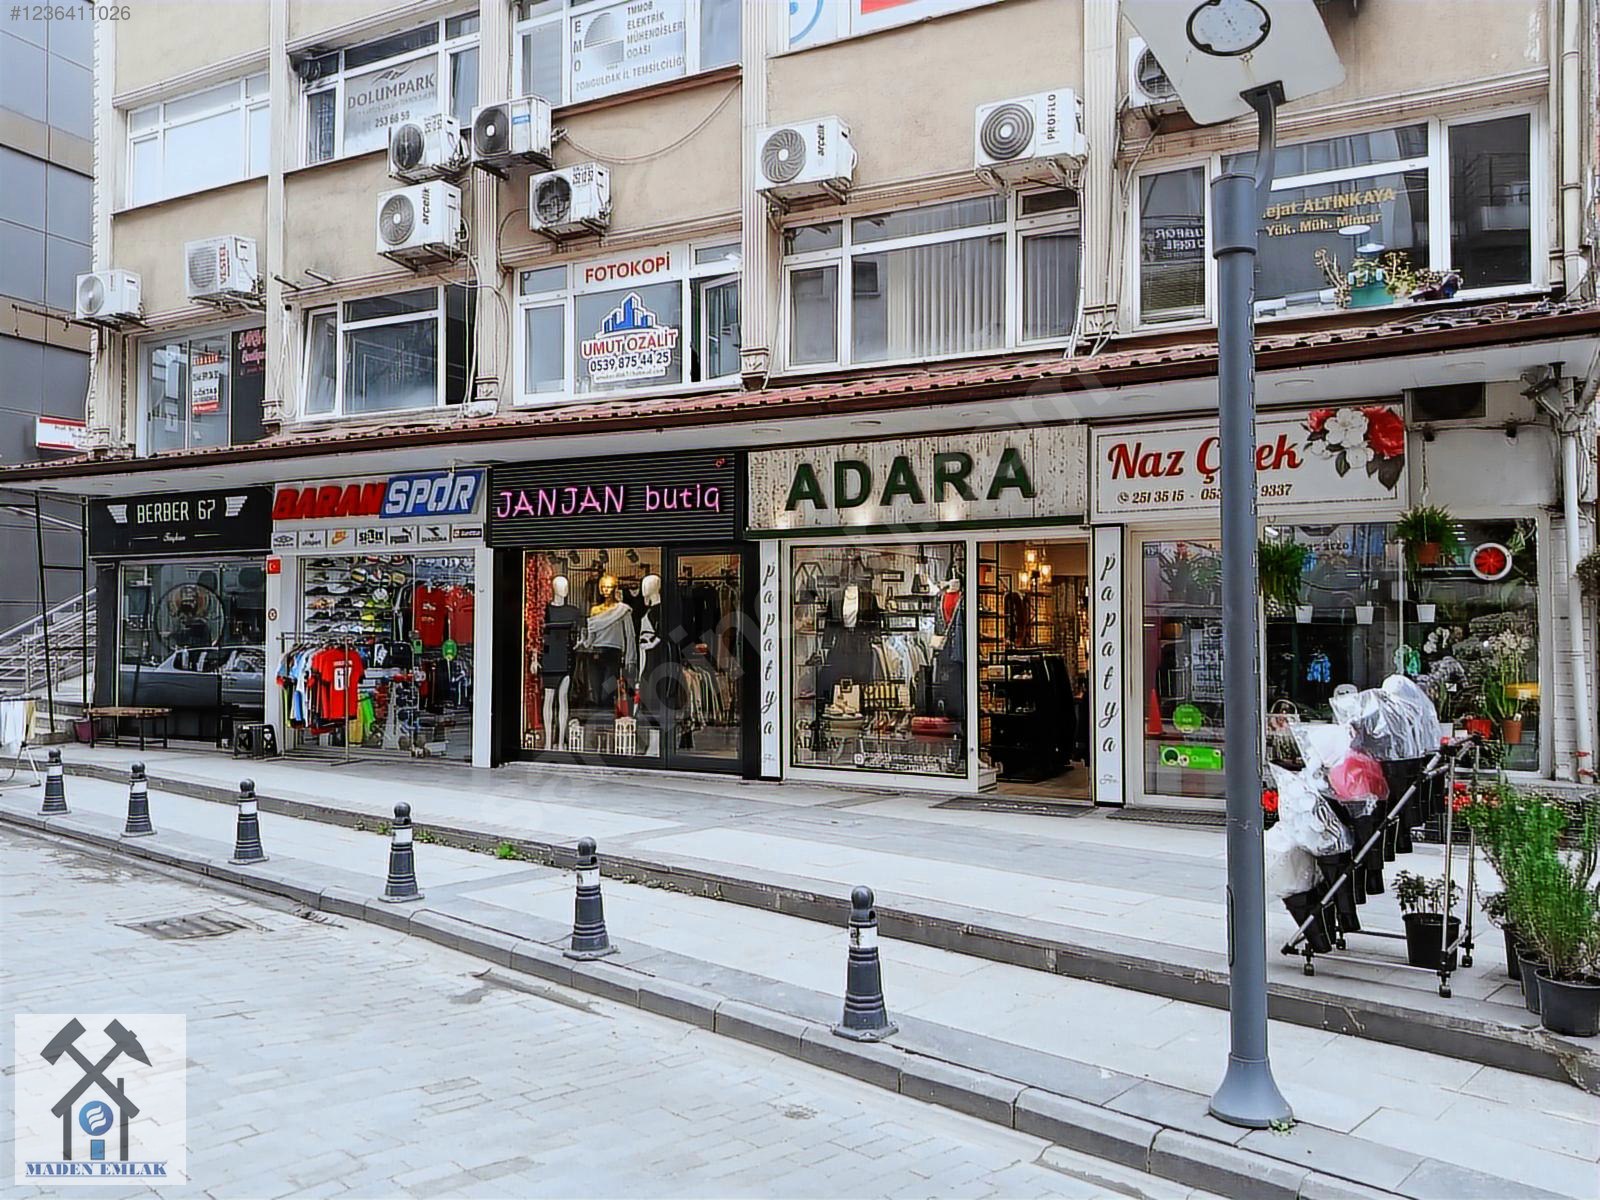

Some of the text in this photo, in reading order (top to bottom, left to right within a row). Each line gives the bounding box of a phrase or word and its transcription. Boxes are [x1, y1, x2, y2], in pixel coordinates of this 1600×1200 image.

[347, 73, 435, 109] DOLUMPARK
[1262, 188, 1396, 220] ejat ALTINKAYA
[1265, 212, 1382, 237] Yük. Müh. Mimar
[585, 251, 671, 283] FOTOKOPİ
[583, 339, 623, 356] UMUT
[590, 351, 669, 373] 0539 875 44 25
[1107, 433, 1304, 484] Naz Çek
[785, 447, 1036, 511] ADARA
[1132, 492, 1150, 504] 251
[1154, 490, 1169, 503] 35
[1172, 489, 1185, 502] 15
[1260, 484, 1292, 497] 9337
[137, 499, 216, 524] BERBER 67
[272, 473, 476, 520] BARAN SPOR
[496, 483, 720, 518] JANJAN butiq
